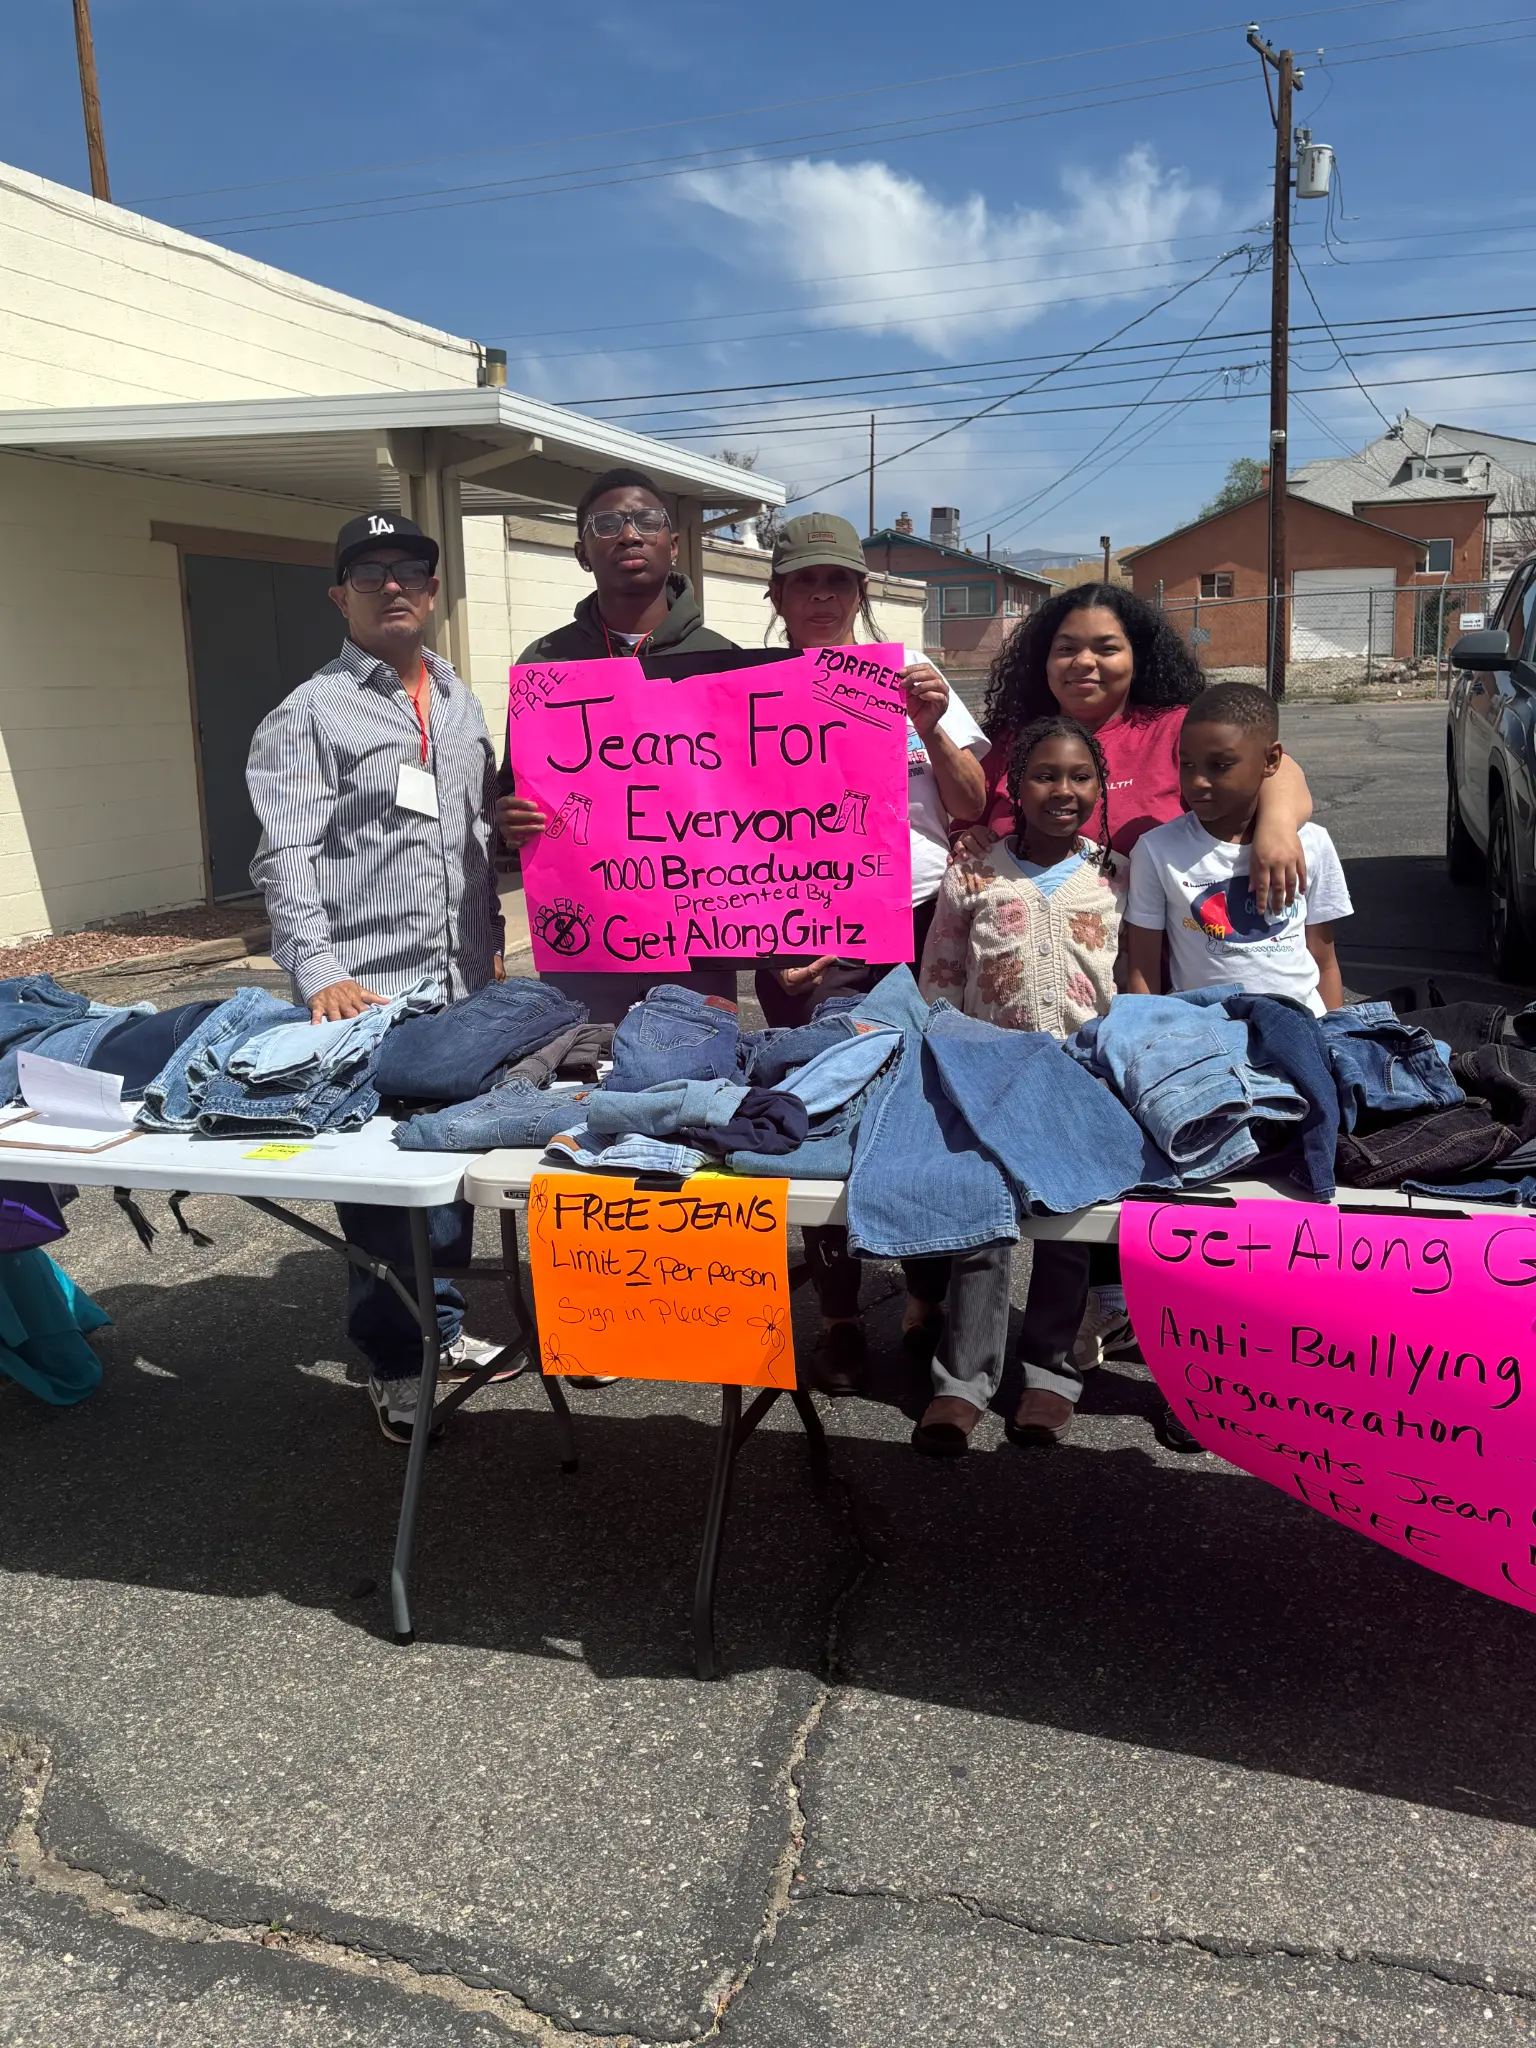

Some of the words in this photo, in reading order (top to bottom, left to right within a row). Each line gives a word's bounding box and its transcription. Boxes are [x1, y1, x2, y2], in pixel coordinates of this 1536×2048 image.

[367, 515, 395, 536] LA
[509, 669, 545, 701] FOR
[511, 667, 569, 720] FREE
[812, 670, 831, 692] 2
[831, 683, 867, 700] per
[862, 695, 908, 717] person
[544, 694, 722, 774] Jeans
[748, 690, 848, 767] For
[627, 784, 847, 843] Everyone
[589, 855, 656, 892] 1000
[661, 852, 855, 891] Broadway
[857, 854, 895, 878] SE
[674, 884, 799, 916] Presented
[806, 884, 832, 909] By
[554, 1193, 651, 1232] FREE
[658, 1195, 777, 1233] JEANS
[551, 1240, 622, 1276] Limit
[626, 1249, 650, 1280] 2
[1148, 1203, 1272, 1272] Get
[1287, 1218, 1453, 1294] Along
[558, 1296, 615, 1331] Sign
[624, 1300, 646, 1322] in
[649, 1298, 731, 1327] Please
[1292, 1472, 1442, 1559] FREE
[1386, 1470, 1512, 1529] Jean
